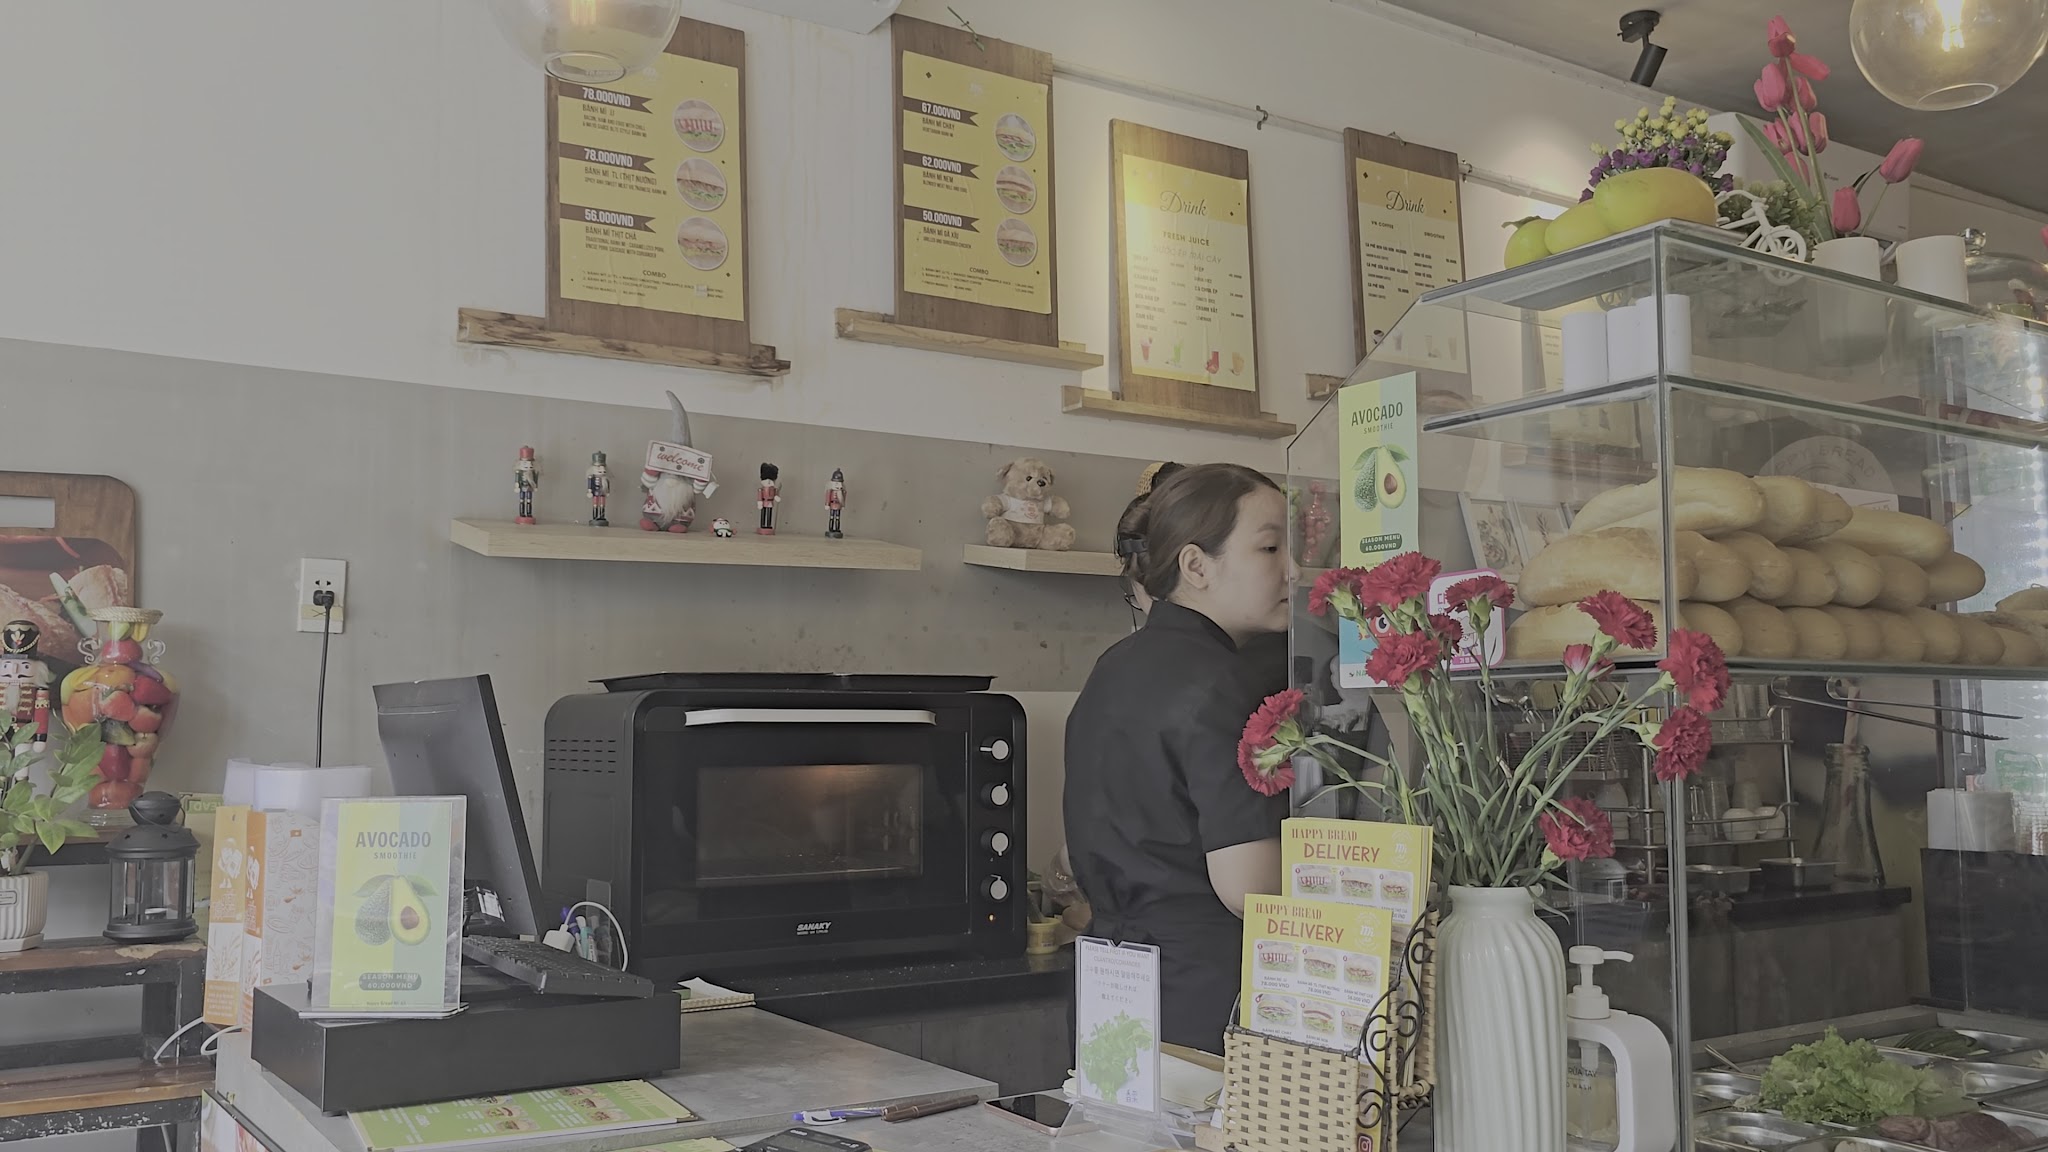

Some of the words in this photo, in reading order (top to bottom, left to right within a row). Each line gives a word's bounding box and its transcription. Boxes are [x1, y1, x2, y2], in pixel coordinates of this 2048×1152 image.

[582, 87, 631, 107] 78.000VND
[922, 102, 961, 120] 67.000VND
[584, 148, 633, 167] 78.000VND
[922, 155, 962, 174] 62.000VND
[1160, 190, 1208, 217] Drink
[1386, 190, 1425, 214] Drink
[584, 208, 634, 227] 56.000VND
[922, 210, 962, 227] 50.000VND
[585, 225, 602, 236] BÁNH
[1188, 234, 1210, 247] JUICE
[642, 270, 667, 279] COMBO
[1351, 401, 1404, 427] AVOCADO
[1364, 422, 1394, 436] SMOOTHIE
[656, 452, 704, 472] welcome
[1362, 536, 1383, 544] SEASON
[355, 831, 432, 848] AVOCADO
[1292, 828, 1324, 840] HAPPY
[1328, 830, 1358, 842] BREAD
[374, 852, 417, 860] SMOOTHIE
[1304, 842, 1380, 863] DELIVERY
[1256, 902, 1289, 916] HAPPY
[1292, 905, 1322, 920] BREAD
[1268, 918, 1344, 944] DELIVERY
